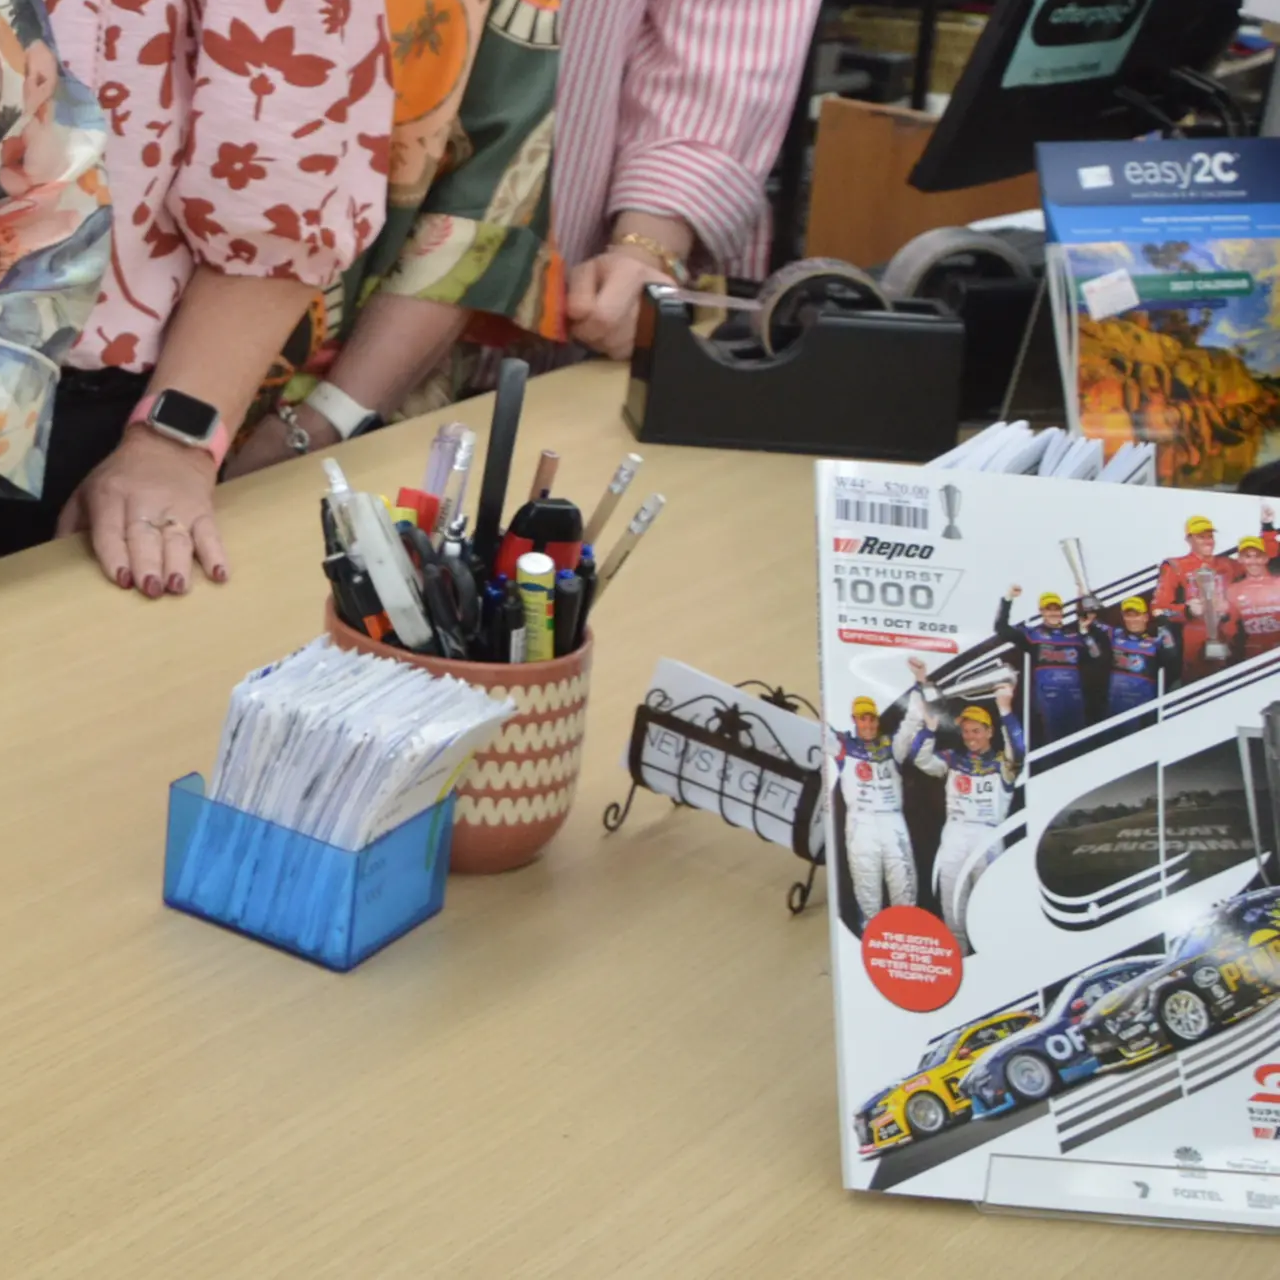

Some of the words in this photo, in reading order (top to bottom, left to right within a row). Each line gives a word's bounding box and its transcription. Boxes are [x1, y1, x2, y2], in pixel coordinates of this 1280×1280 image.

[859, 536, 935, 561] Repco
[833, 564, 945, 584] BATHURST
[833, 577, 935, 610] 1000
[883, 618, 913, 629] OCT
